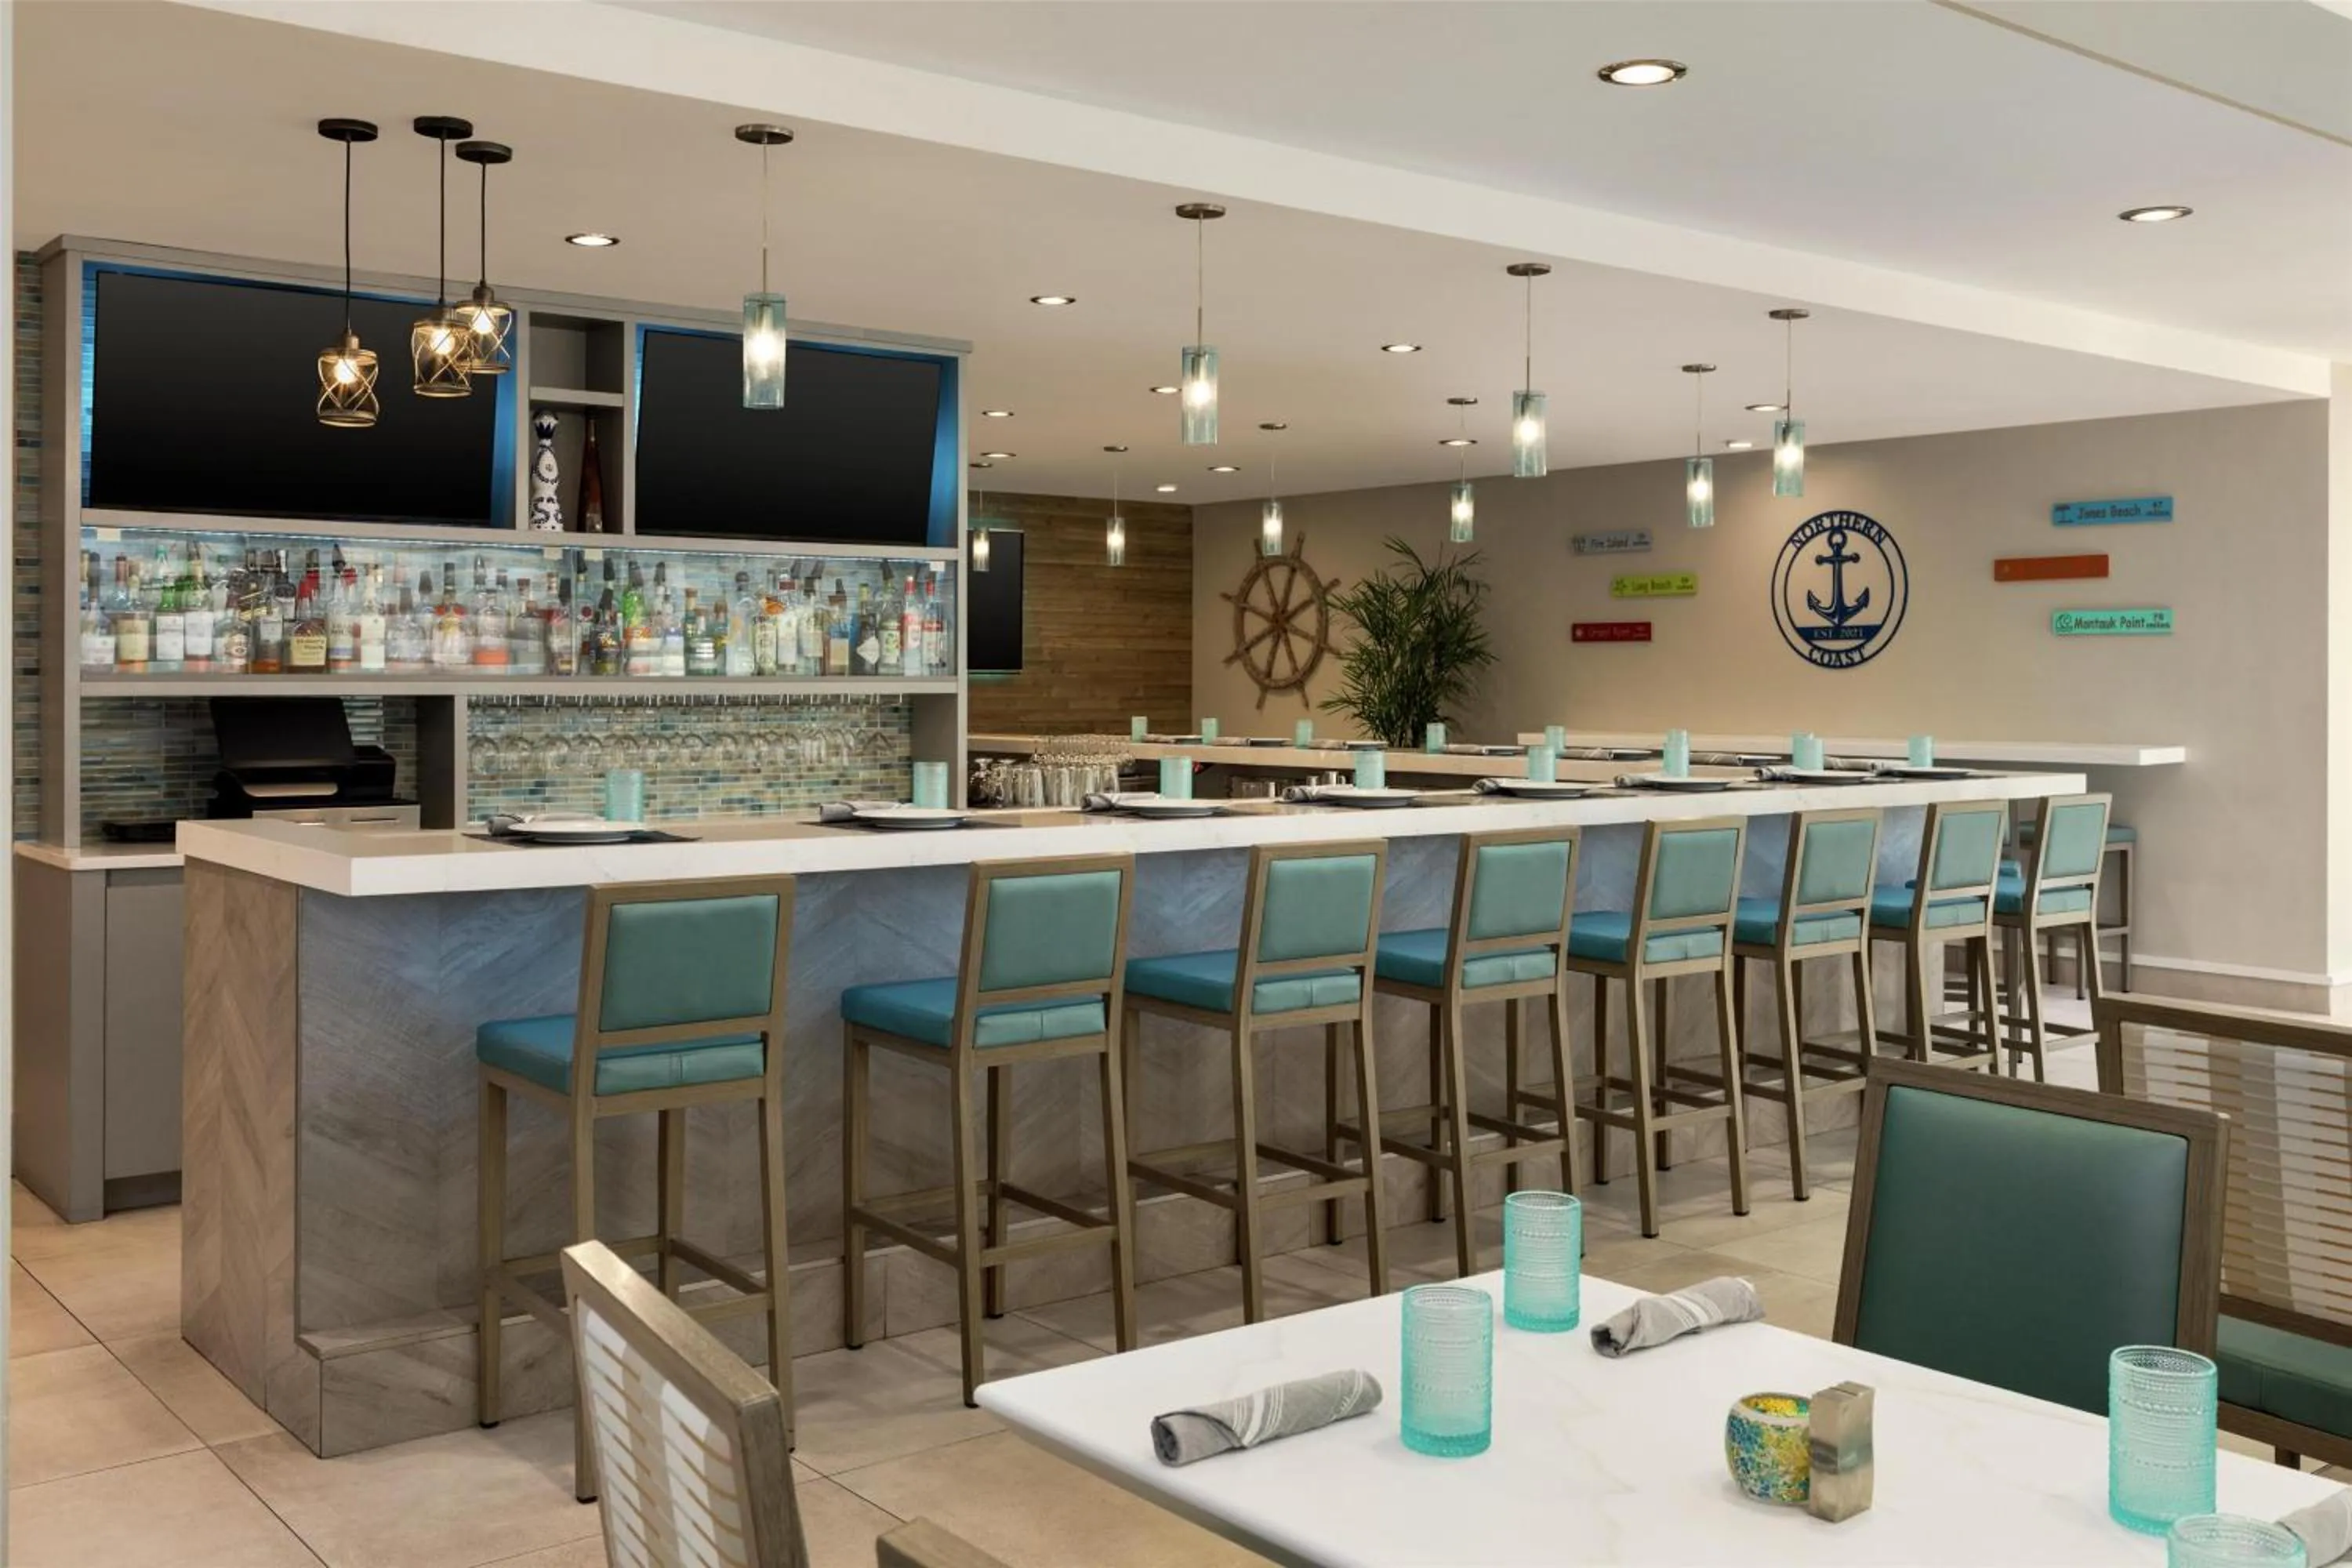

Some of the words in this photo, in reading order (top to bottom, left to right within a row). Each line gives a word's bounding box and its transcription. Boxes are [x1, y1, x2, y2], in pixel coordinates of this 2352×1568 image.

[2078, 507, 2107, 520] Jones
[2109, 503, 2142, 517] Beach
[1791, 513, 1887, 550] NORTHERN
[2074, 616, 2116, 630] Montauk
[2119, 615, 2146, 630] Point
[1807, 646, 1866, 666] COAST
